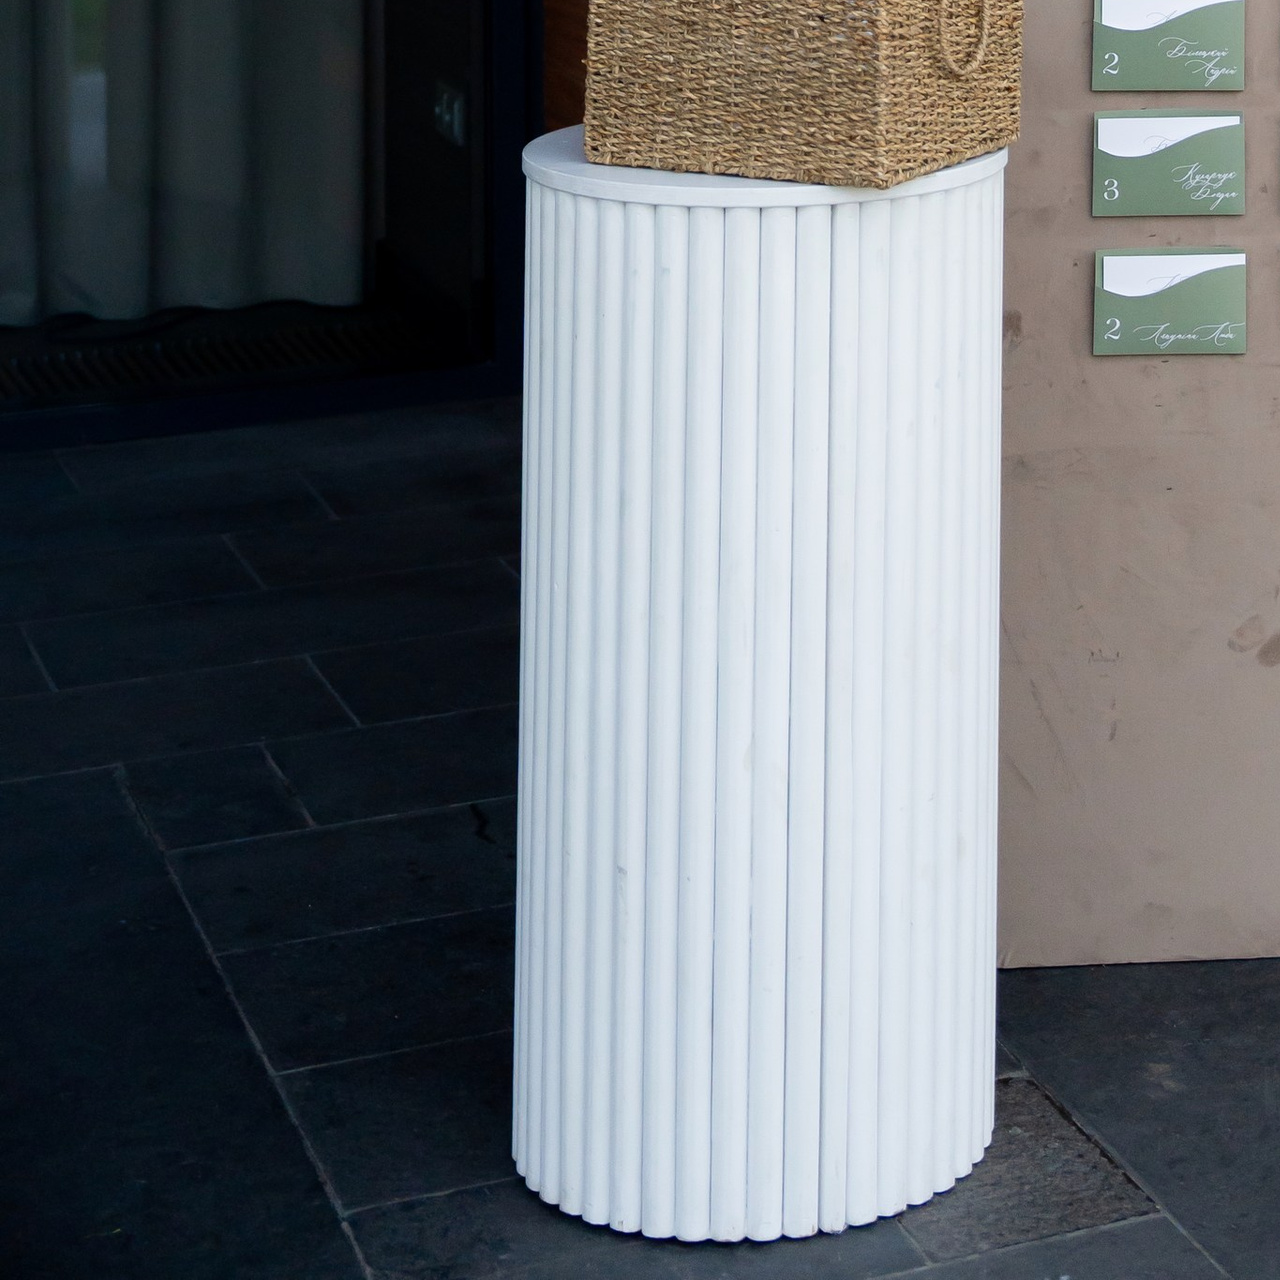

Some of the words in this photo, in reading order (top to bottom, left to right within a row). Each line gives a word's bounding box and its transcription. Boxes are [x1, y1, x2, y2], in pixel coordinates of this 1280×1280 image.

[1102, 52, 1119, 75] 2
[1103, 179, 1119, 201] 3
[1104, 318, 1121, 339] 2
